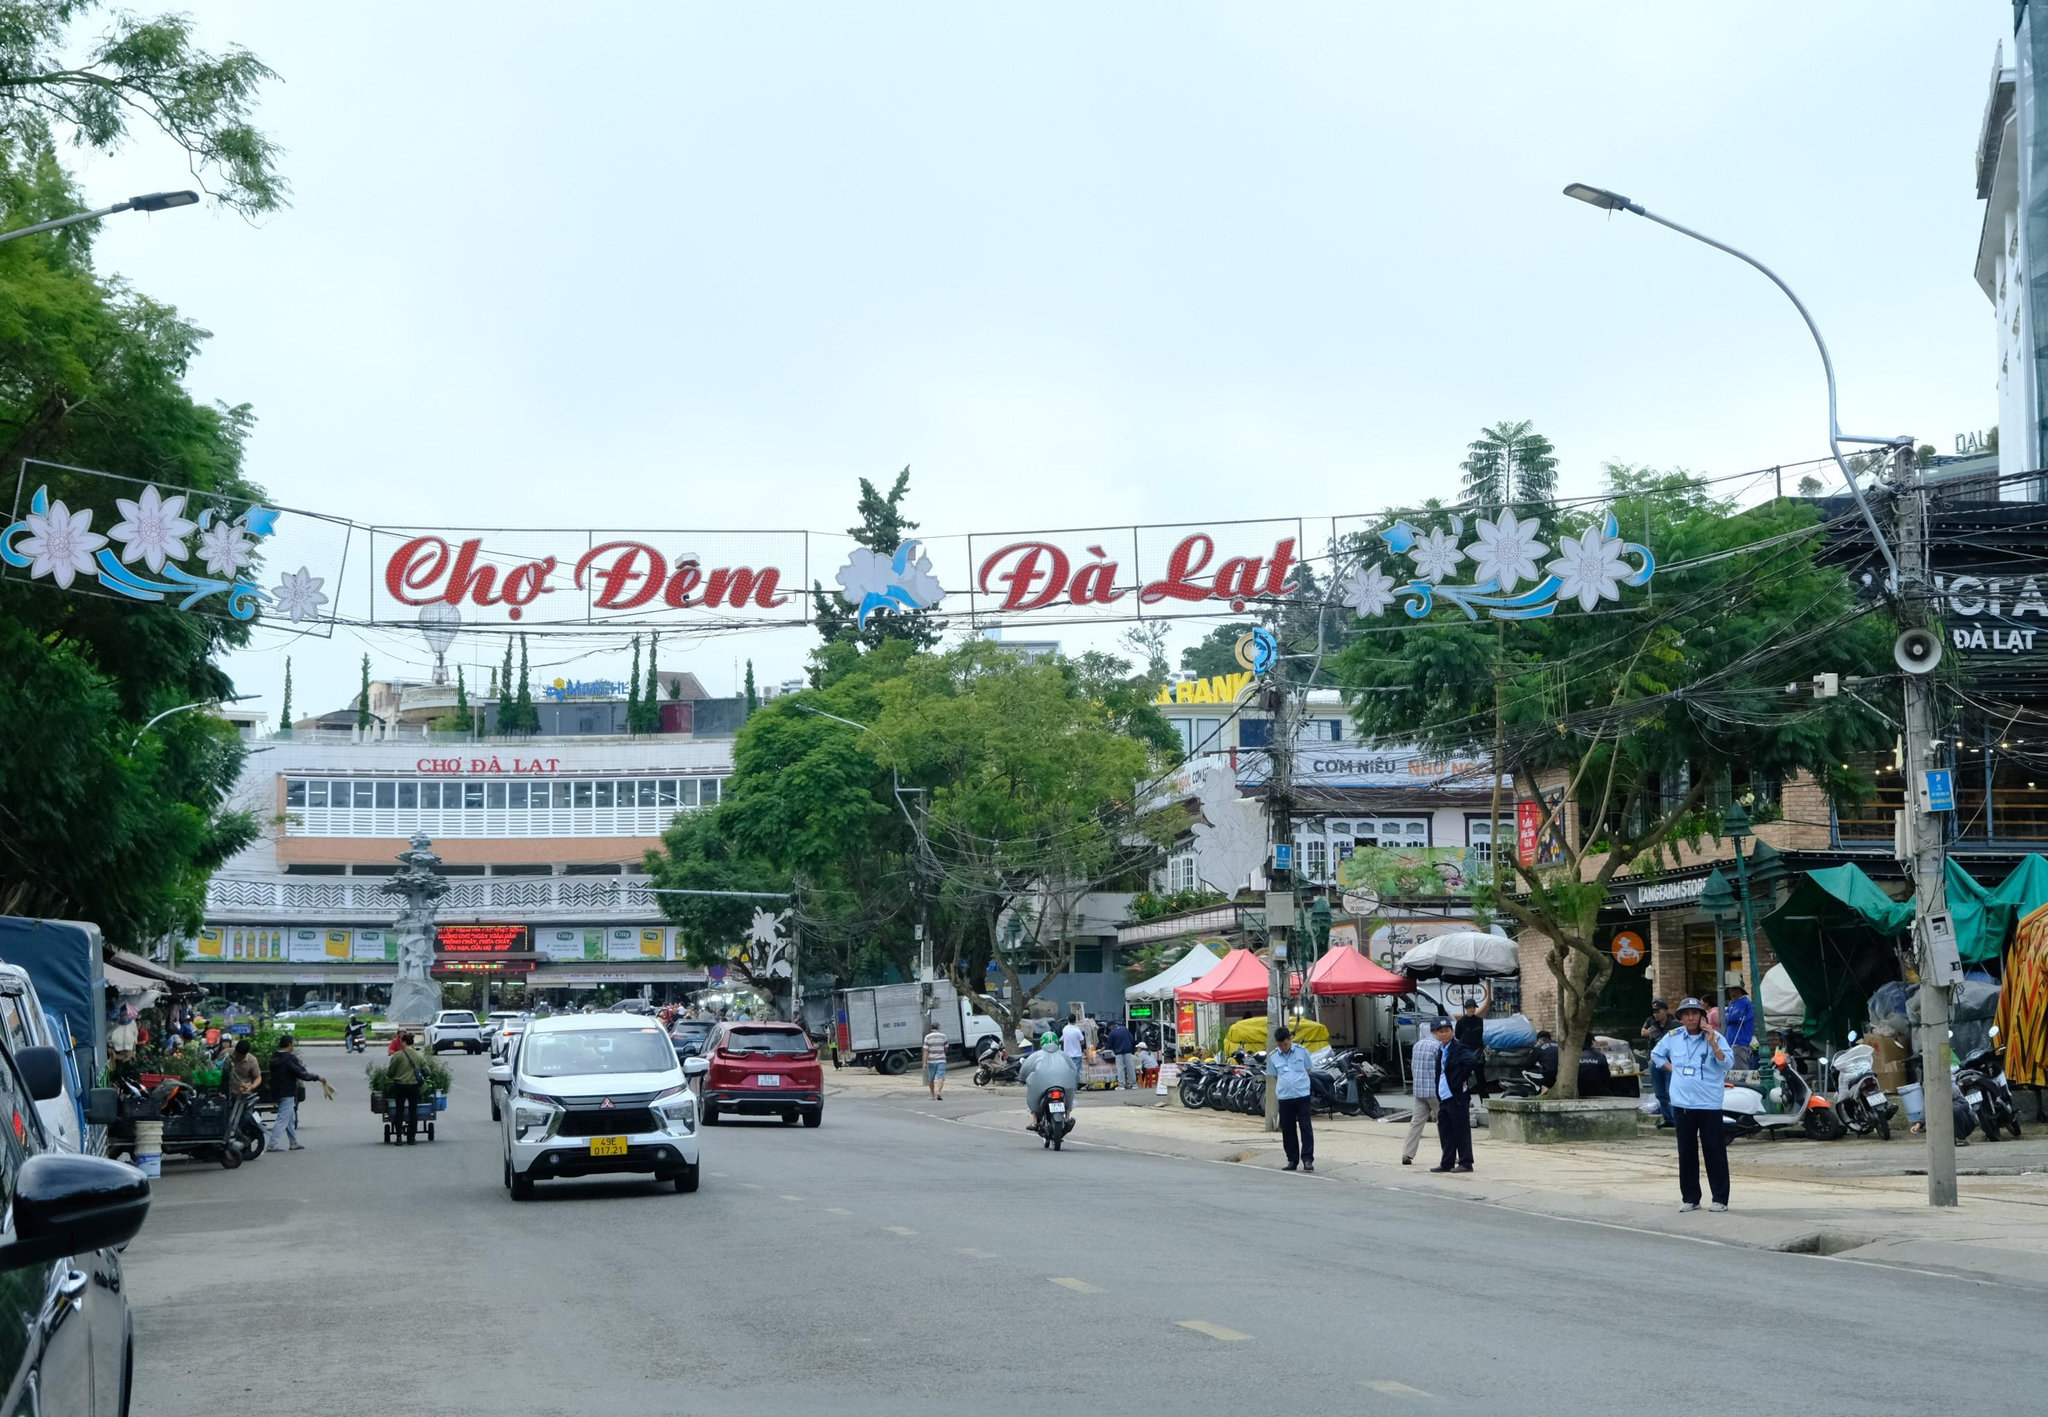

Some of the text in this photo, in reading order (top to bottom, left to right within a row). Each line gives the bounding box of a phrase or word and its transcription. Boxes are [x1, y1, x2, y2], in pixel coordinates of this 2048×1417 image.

[385, 532, 1301, 621] Chợ Đêm Đà Lạt
[1953, 622, 2037, 654] ĐÀ LẠT
[1176, 671, 1253, 703] BANK
[417, 756, 561, 776] CHỢ ĐÀ LẠT
[594, 1146, 623, 1155] 017.21
[601, 1137, 617, 1146] 49E
